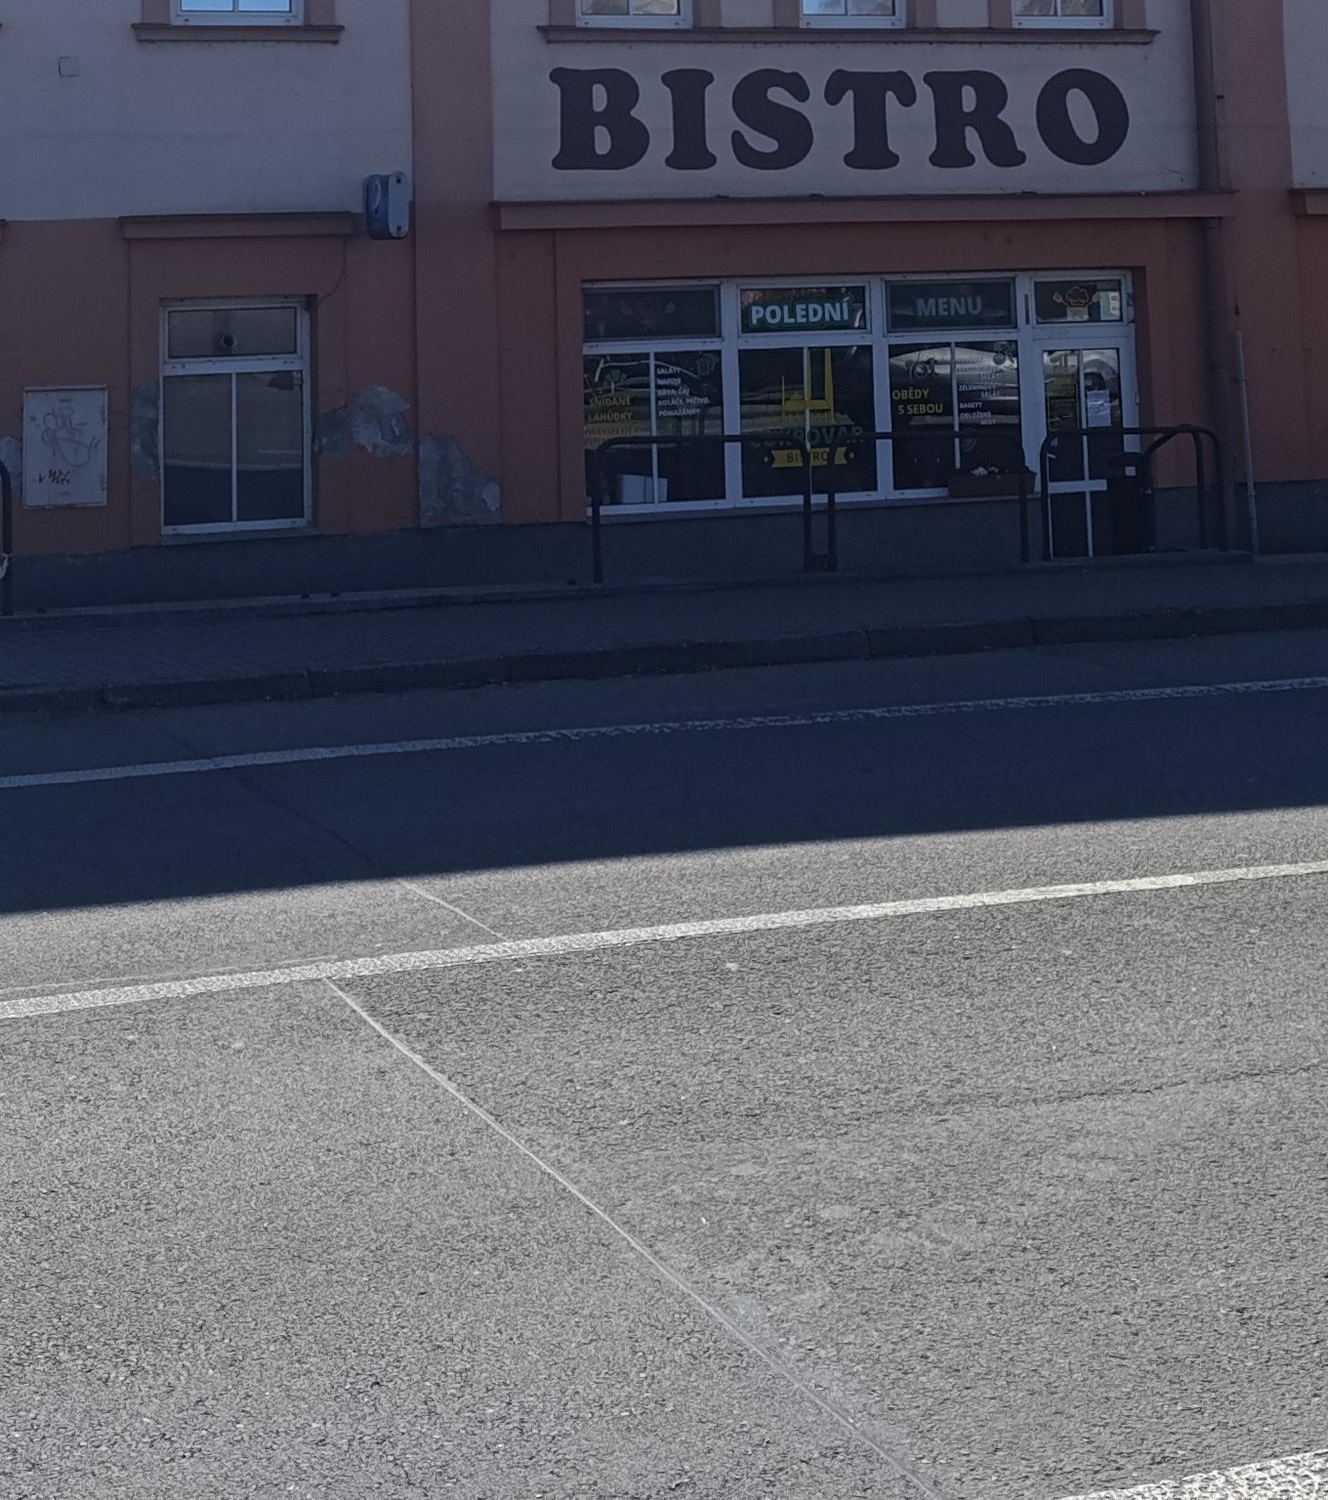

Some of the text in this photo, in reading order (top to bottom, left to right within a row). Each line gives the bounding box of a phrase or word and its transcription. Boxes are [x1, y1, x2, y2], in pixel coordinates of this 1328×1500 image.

[549, 67, 1130, 171] BISTRO
[751, 296, 851, 326] POLEDNÍ
[916, 296, 983, 318] MENU
[892, 385, 929, 400] OBĚDY
[588, 410, 633, 422] LAHŮDKY
[898, 402, 944, 416] S SEBOU
[787, 450, 829, 464] BIRO
